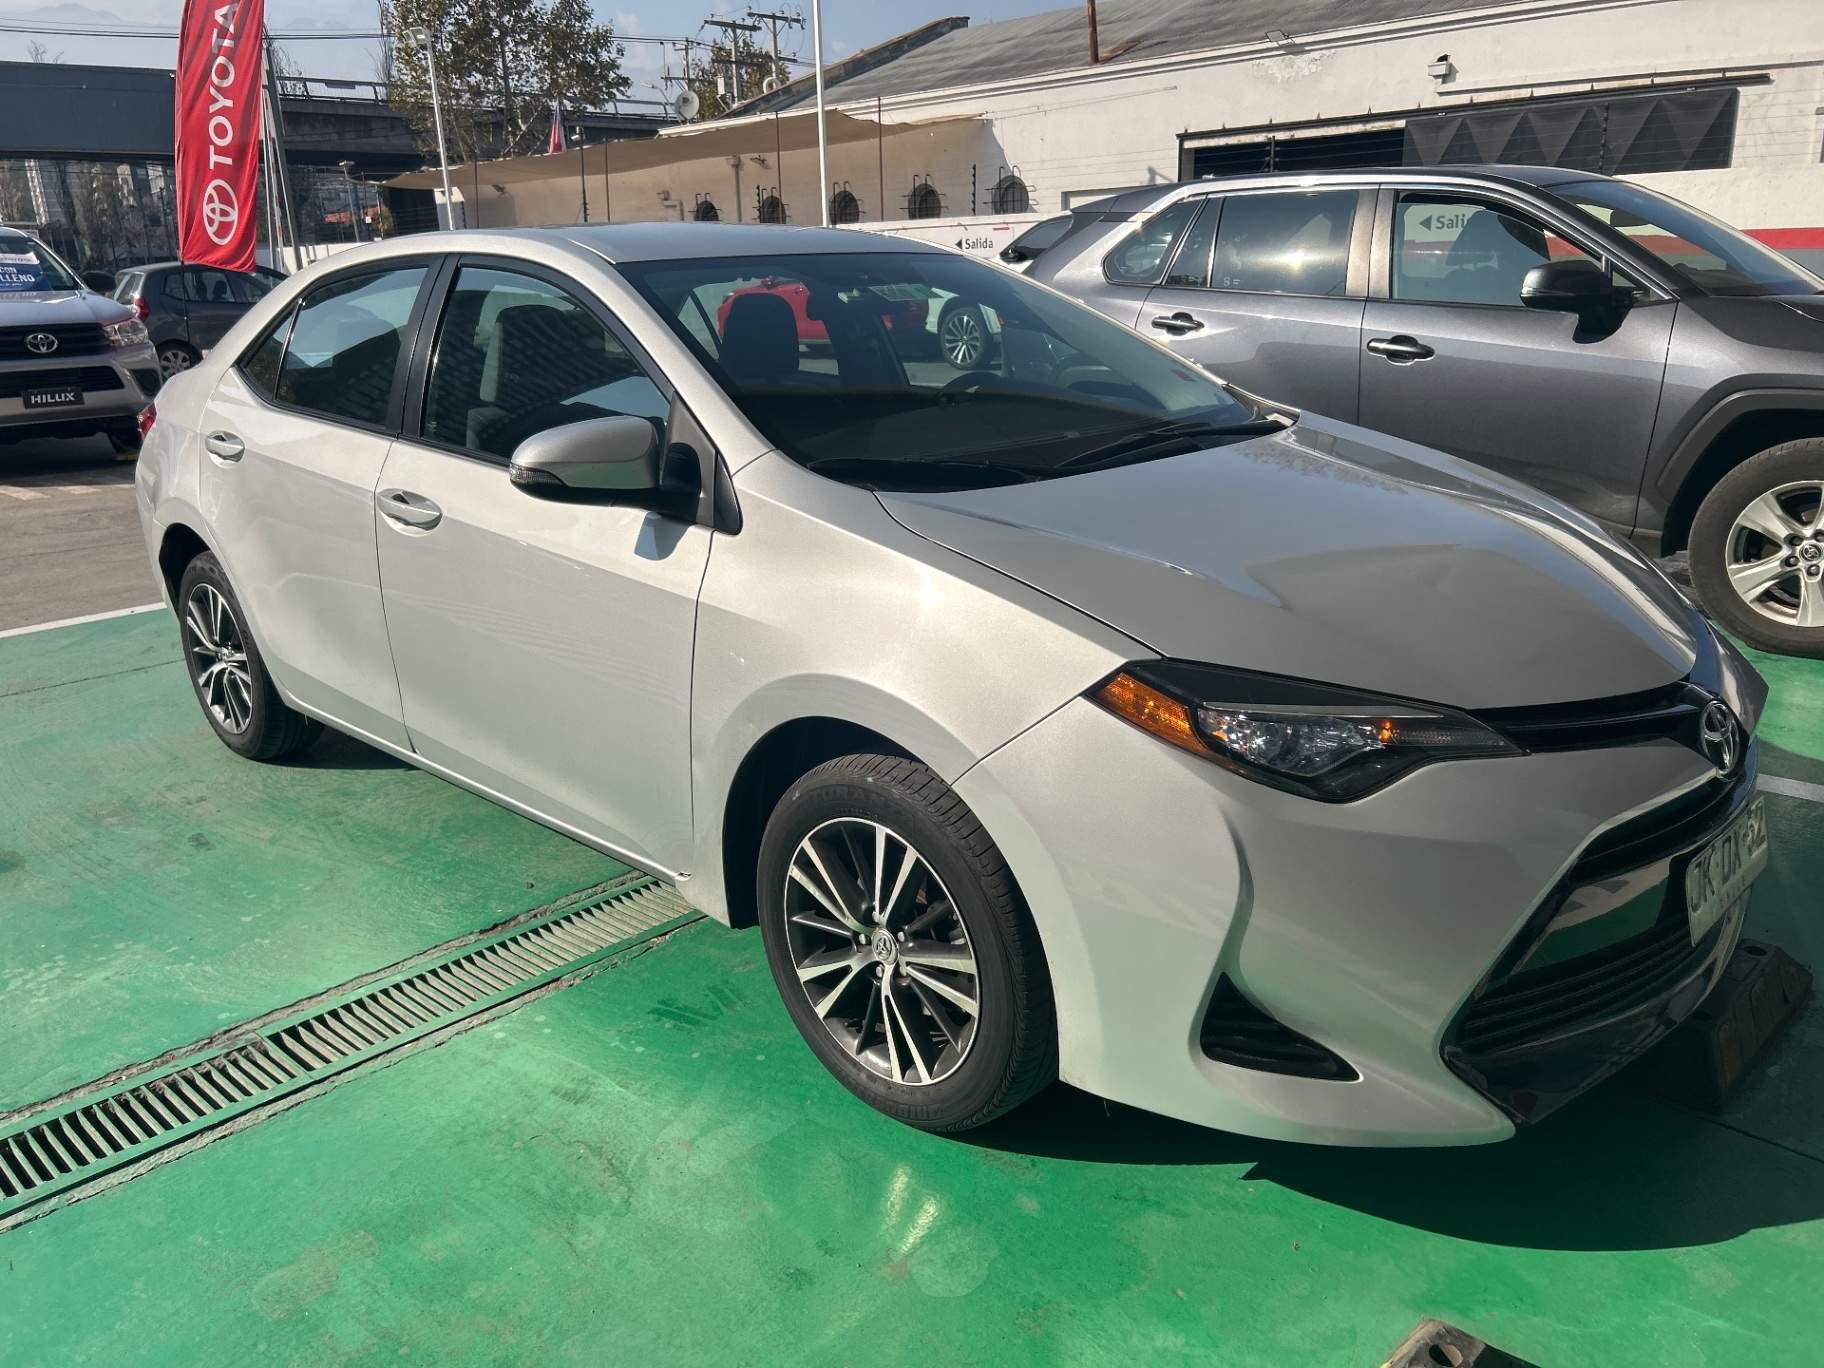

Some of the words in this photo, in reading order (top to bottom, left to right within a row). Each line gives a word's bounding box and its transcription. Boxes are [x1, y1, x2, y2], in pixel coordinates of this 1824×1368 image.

[208, 3, 239, 170] TOYOTA
[1435, 214, 1467, 230] Sali
[965, 237, 994, 250] Salida
[31, 392, 75, 404] HILUX
